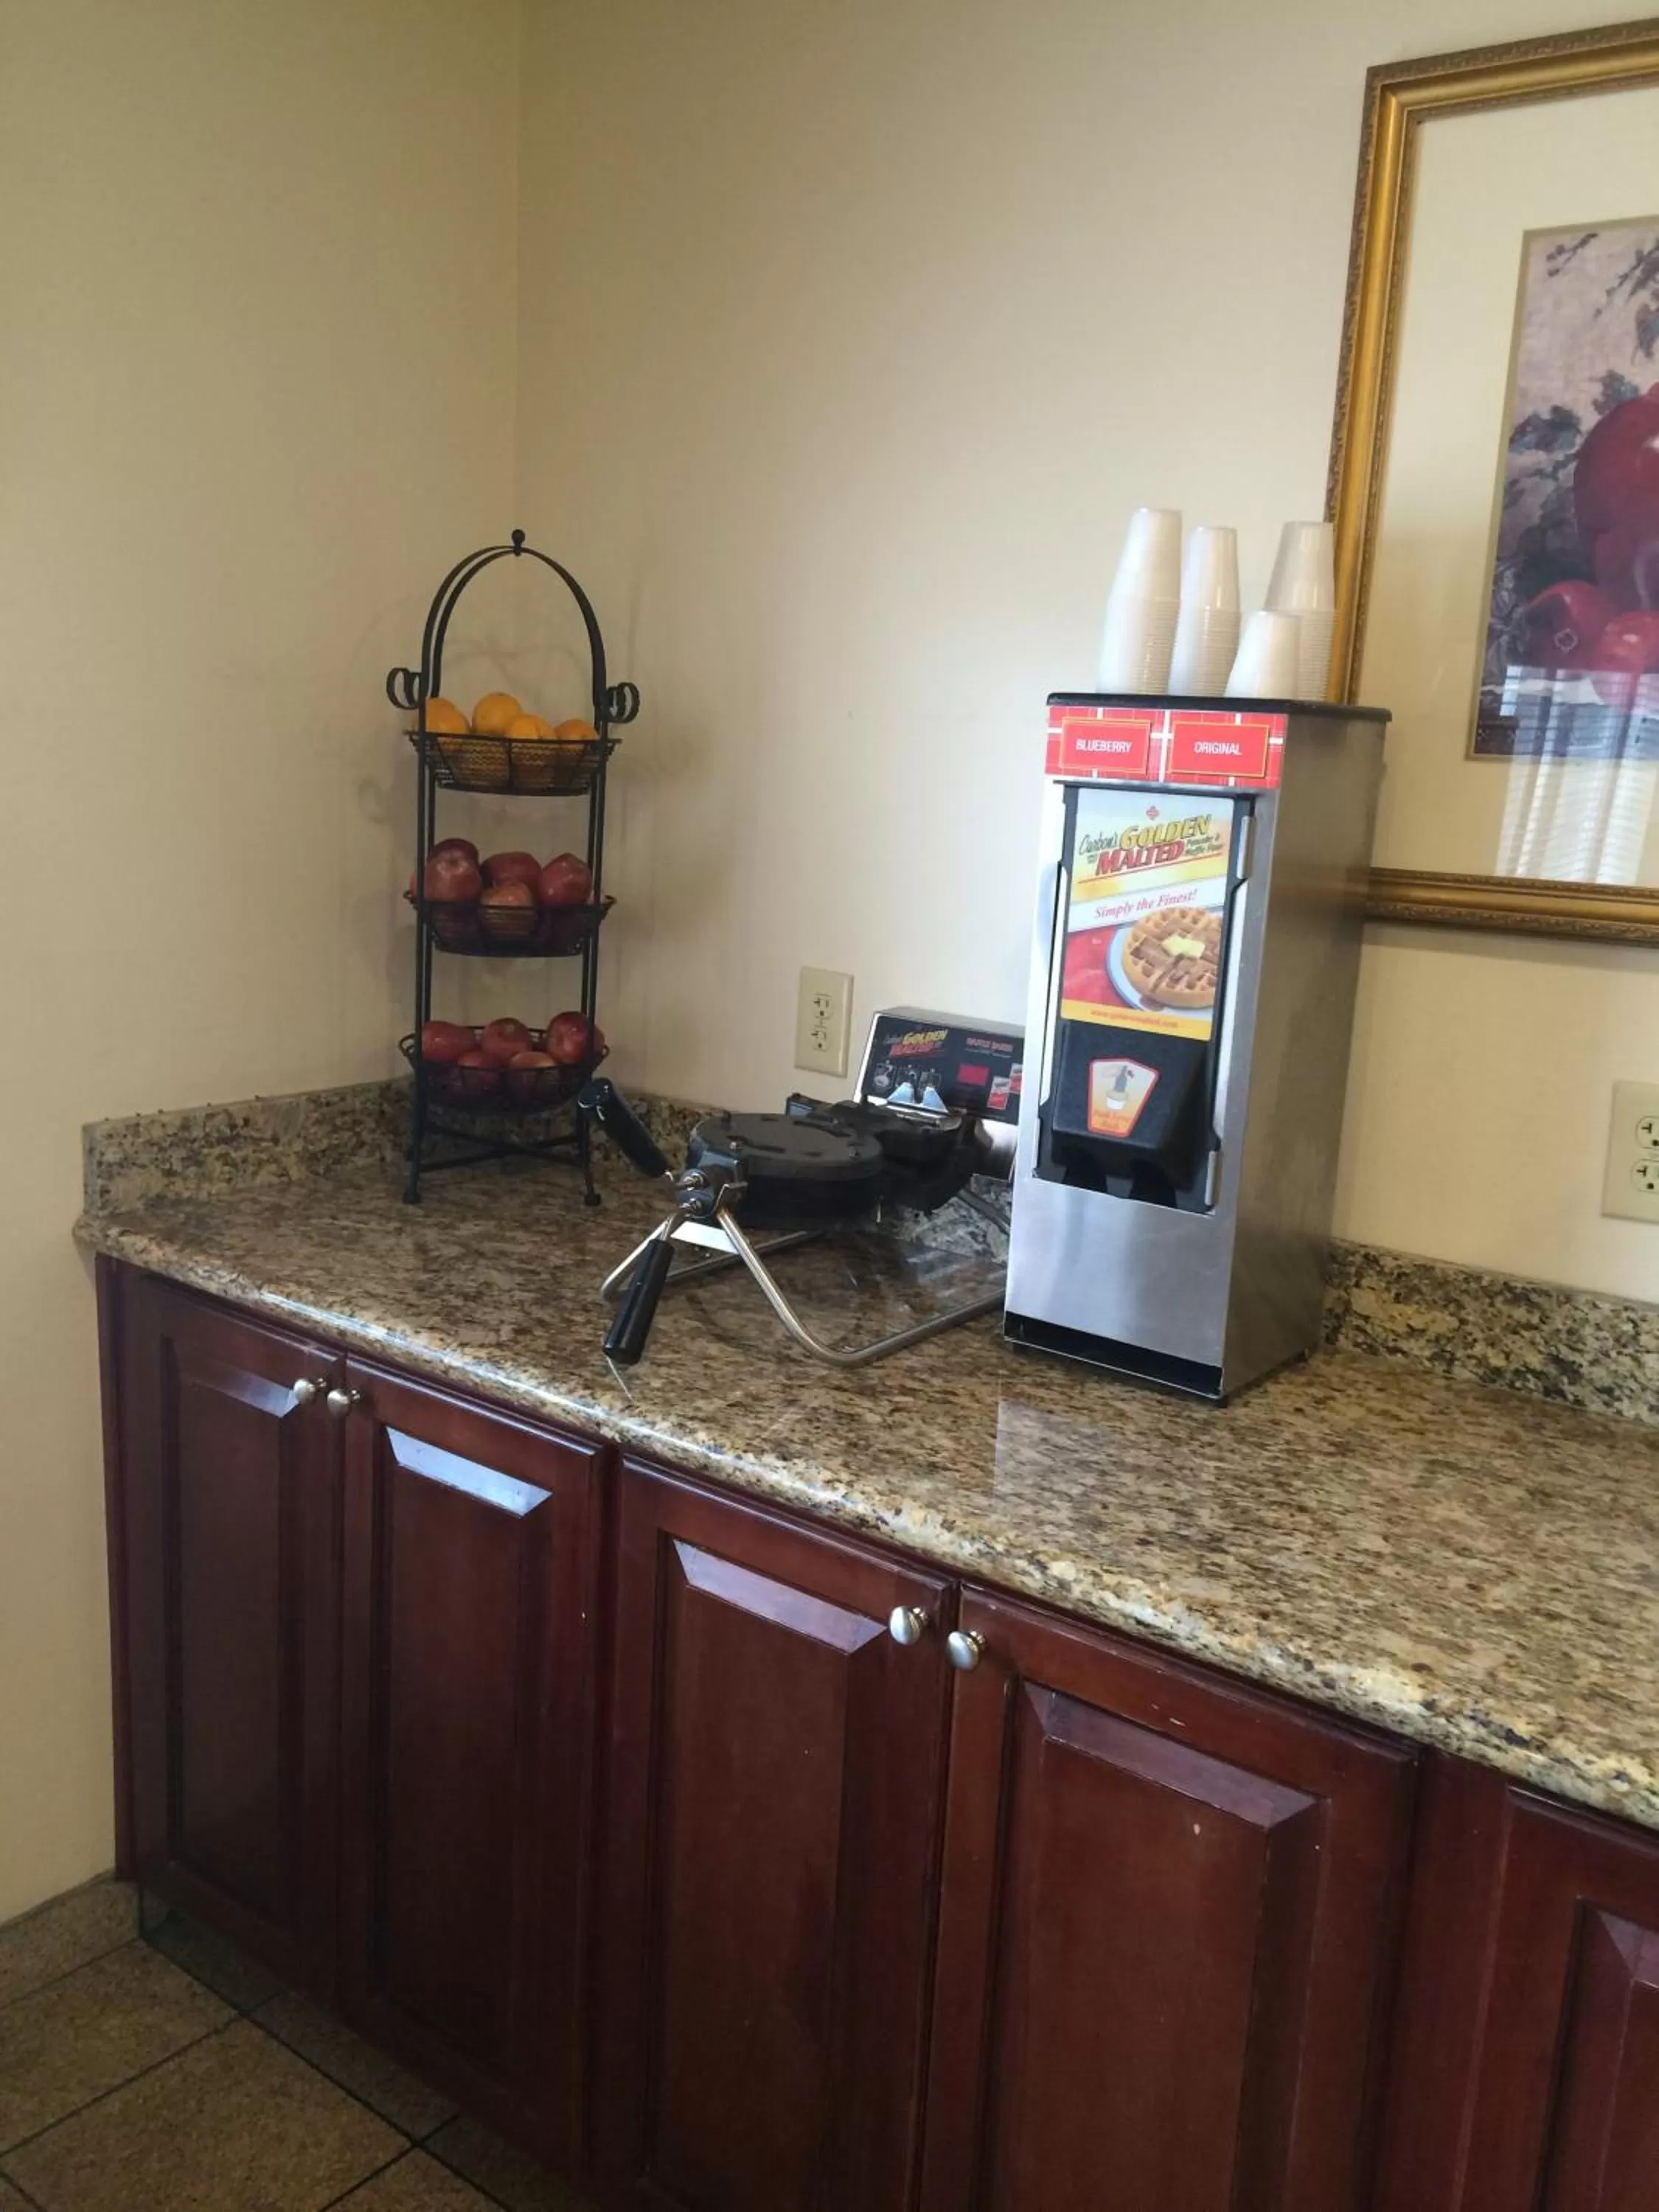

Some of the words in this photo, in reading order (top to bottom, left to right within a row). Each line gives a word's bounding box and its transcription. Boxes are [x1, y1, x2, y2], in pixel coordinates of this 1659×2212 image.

[1076, 739, 1133, 753] BLUEBERRY
[1194, 741, 1242, 756] ORIGINAL
[1119, 814, 1212, 849] GOLDEN
[1095, 839, 1186, 876] MALTED
[1094, 900, 1134, 919] Simply
[1135, 897, 1155, 911] the
[1158, 888, 1198, 907] Finest!
[902, 1029, 948, 1046] GOLDEN
